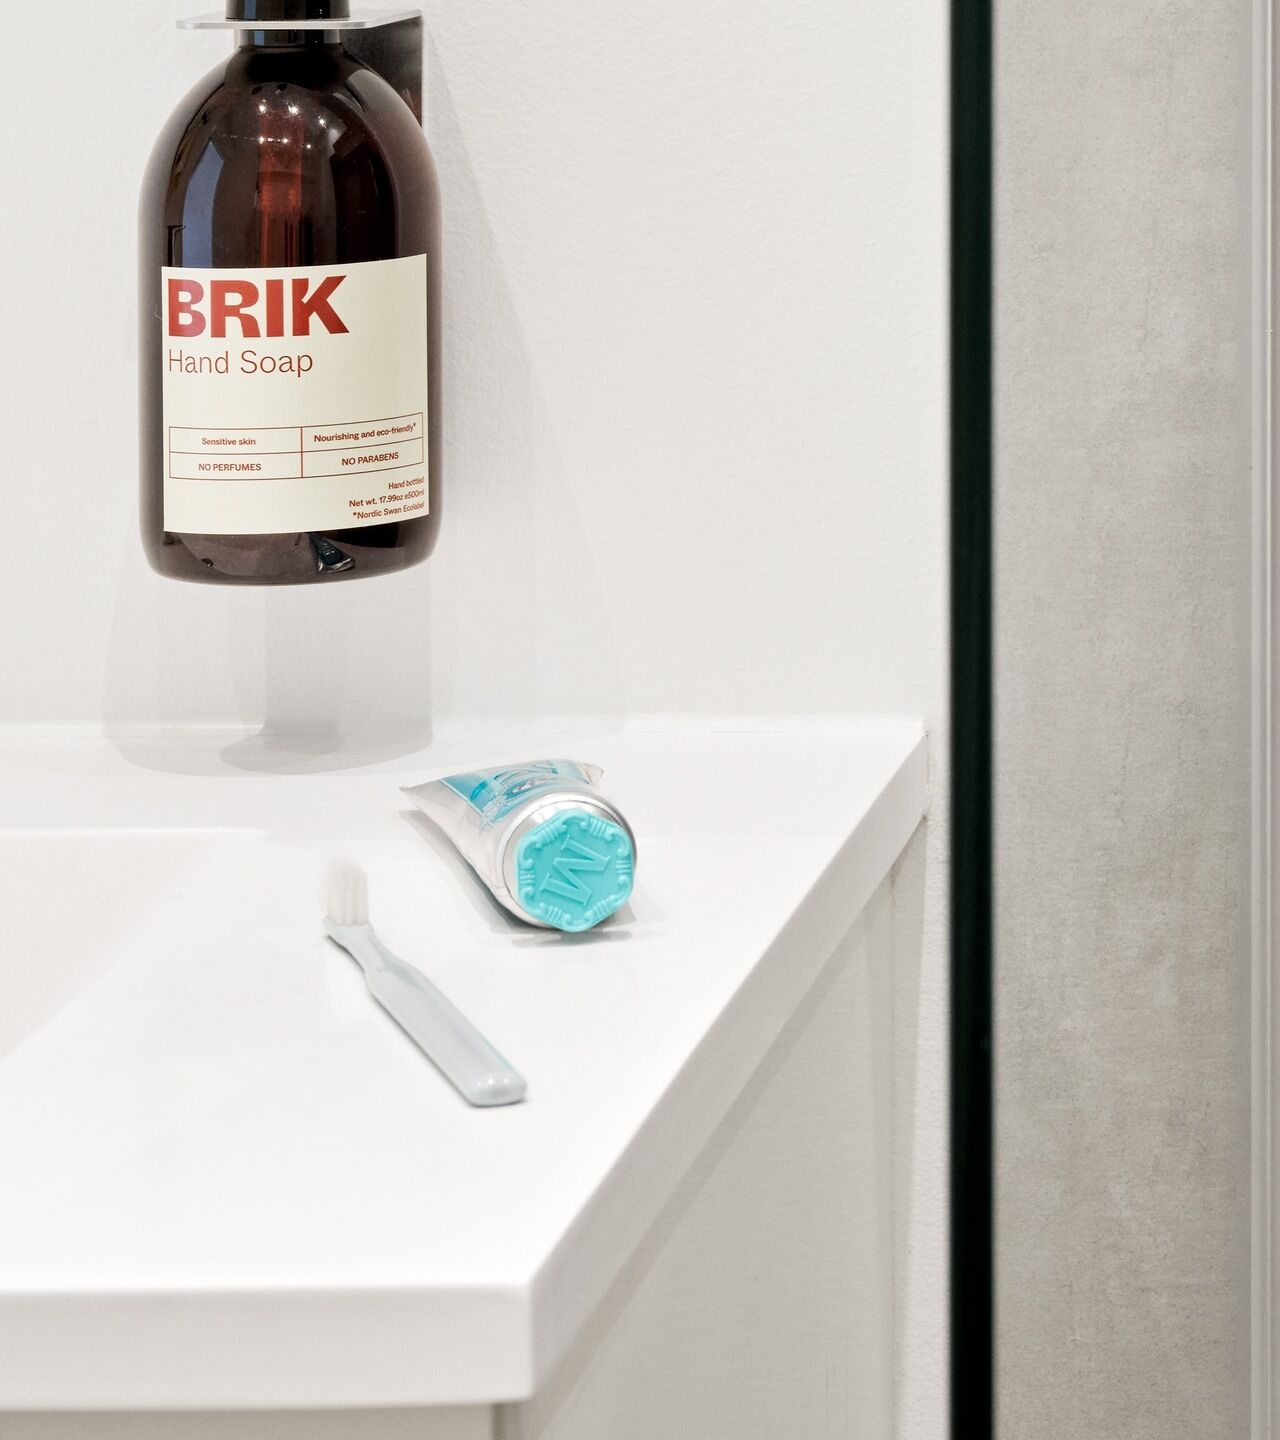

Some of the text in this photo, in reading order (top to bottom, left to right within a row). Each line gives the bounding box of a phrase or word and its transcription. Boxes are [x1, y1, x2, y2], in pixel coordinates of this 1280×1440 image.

[168, 275, 350, 338] BRIK
[169, 349, 313, 378] Hand Soap
[201, 437, 237, 445] Sensitive
[314, 432, 359, 442] Nourishing
[361, 430, 375, 438] and
[341, 451, 399, 466] NO PARABENS
[198, 463, 262, 471] NO PERFUMES
[388, 481, 405, 490] Hand
[349, 499, 363, 507] Net
[379, 494, 403, 503] 17.99oz
[383, 507, 402, 516] Swan
